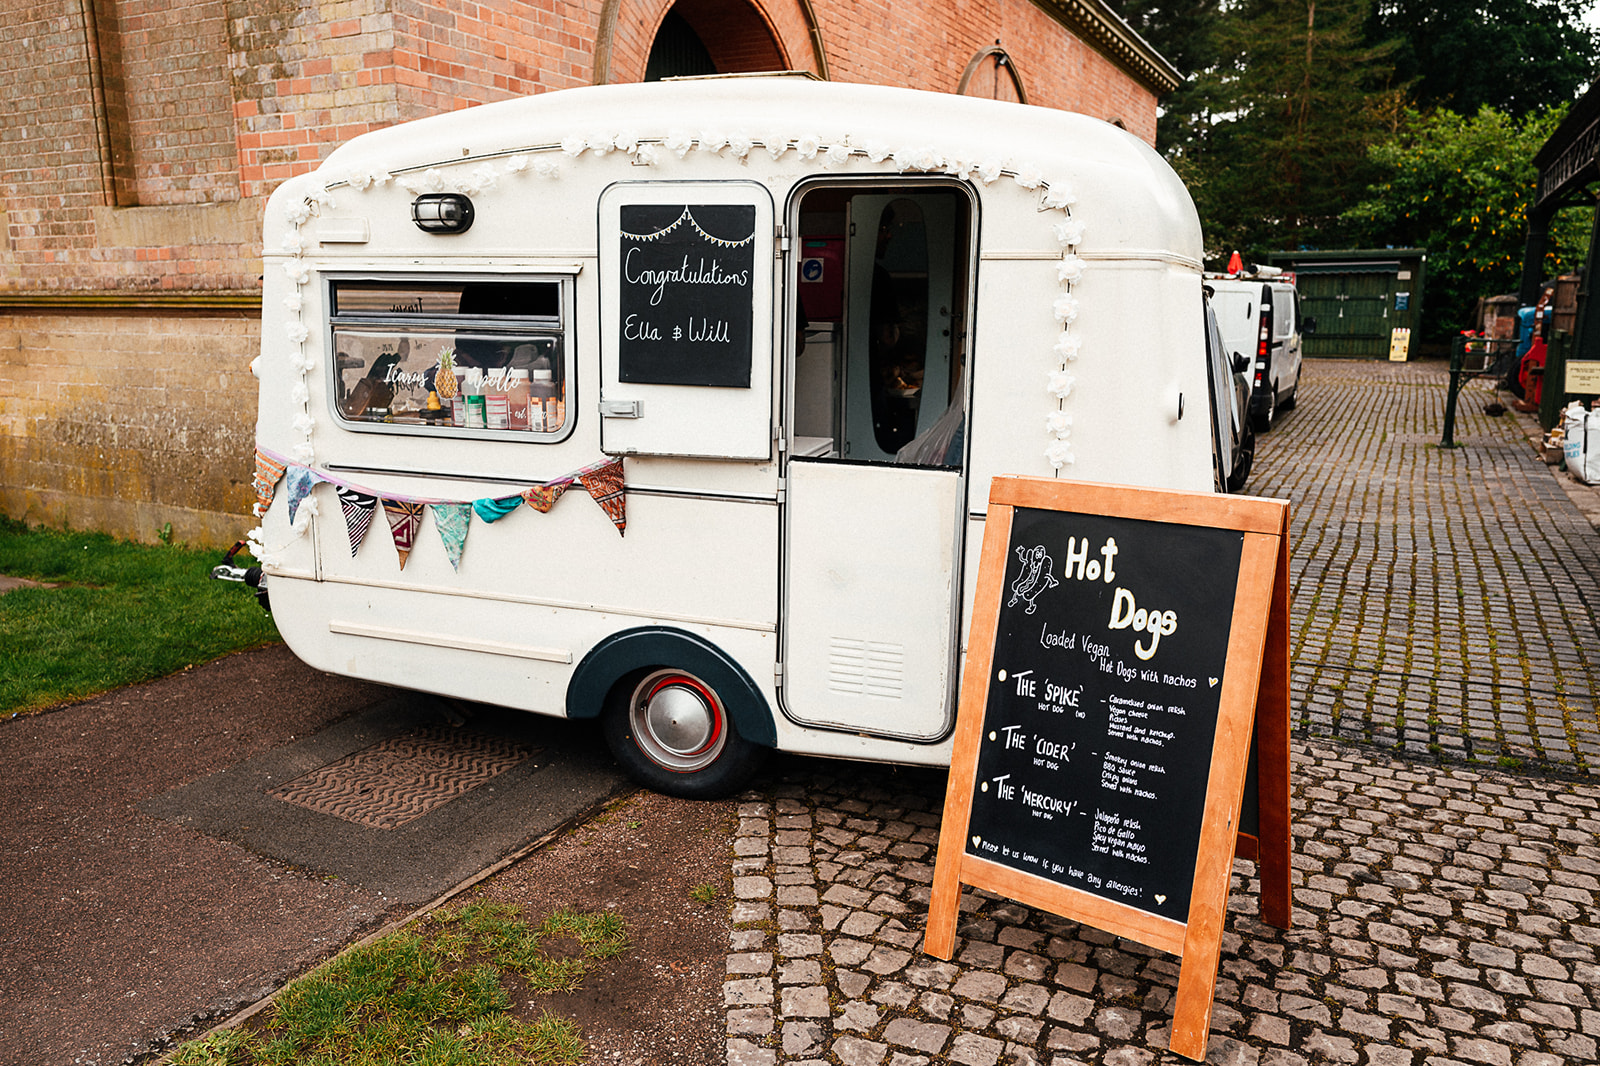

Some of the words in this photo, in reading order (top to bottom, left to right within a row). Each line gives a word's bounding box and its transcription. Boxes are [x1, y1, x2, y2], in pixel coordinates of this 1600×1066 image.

[625, 247, 748, 306] Congratulations
[625, 314, 662, 341] Ella
[689, 317, 730, 342] Will
[384, 363, 429, 387] Icarus
[1065, 536, 1118, 583] Hot
[1108, 587, 1177, 660] Dogs
[1040, 622, 1076, 649] Loaded
[1082, 635, 1110, 662] Vegan
[1100, 657, 1113, 673] Hot
[1117, 661, 1137, 682] Dogs
[1163, 674, 1197, 688] nachos
[1038, 703, 1050, 711] HOT
[1052, 705, 1064, 713] DOG
[1109, 705, 1126, 716] Vegan
[1134, 727, 1146, 735] and
[1033, 758, 1045, 766] HOT
[1047, 761, 1059, 770] DOG
[1103, 761, 1115, 772] BBQ
[1094, 821, 1106, 832] Pico
[1108, 826, 1115, 834] de
[1117, 828, 1135, 839] Gallo
[1127, 842, 1146, 853] mayo
[1002, 845, 1010, 856] let
[1012, 850, 1020, 858] us
[1023, 852, 1038, 864] know
[1042, 858, 1049, 869] if
[1052, 863, 1064, 874] you
[1068, 866, 1084, 879] have
[1088, 873, 1101, 888] any
[1106, 880, 1142, 897] allergies!
